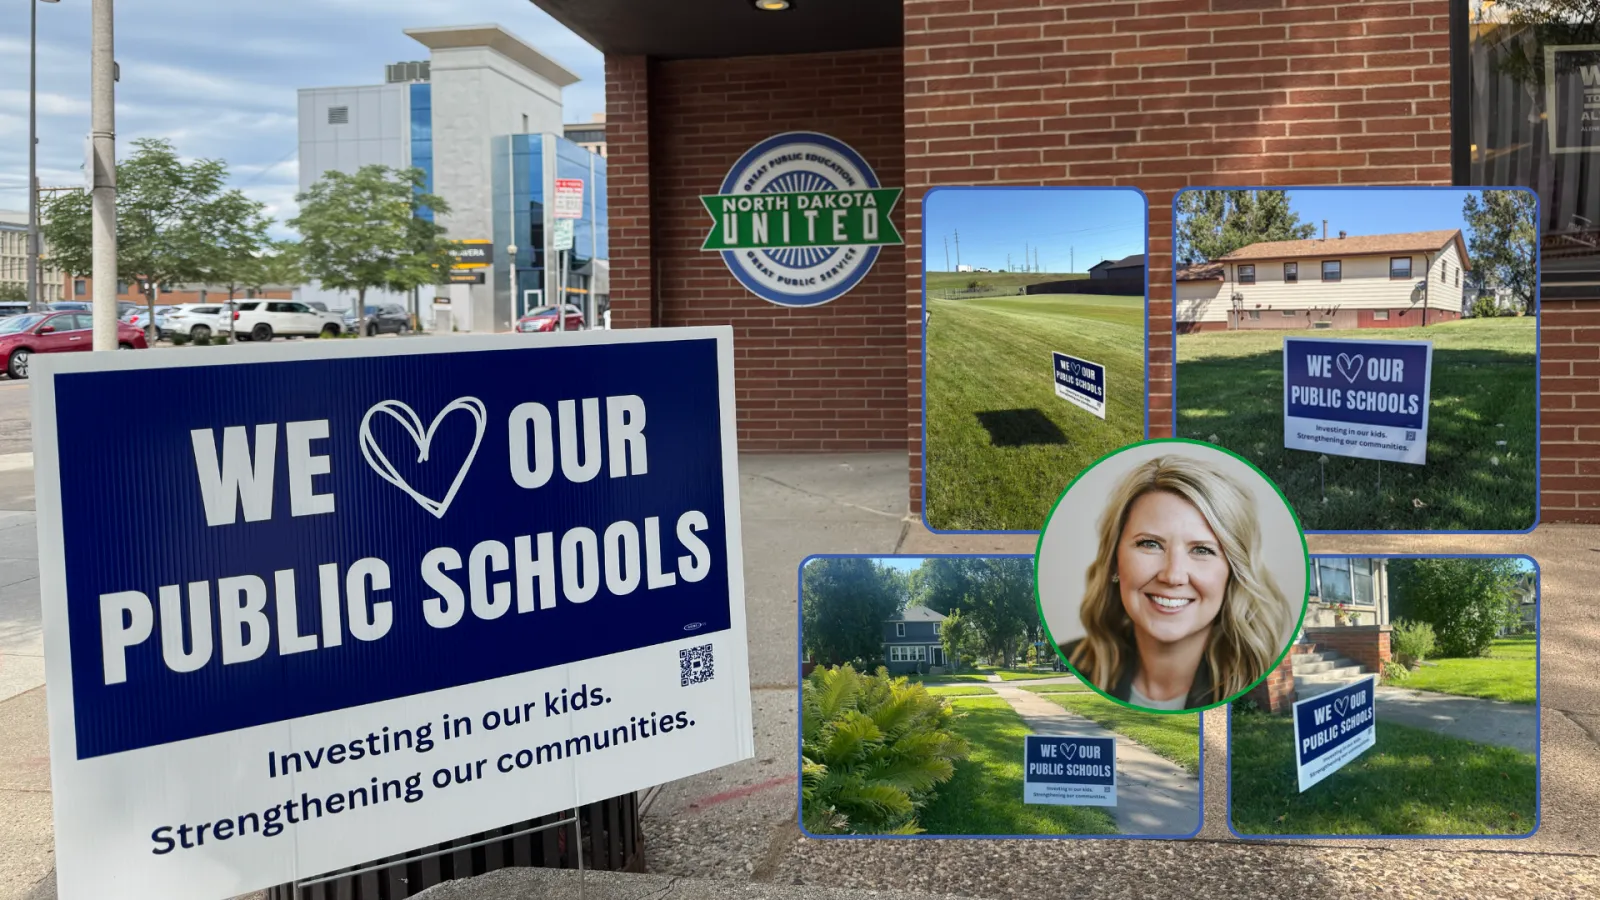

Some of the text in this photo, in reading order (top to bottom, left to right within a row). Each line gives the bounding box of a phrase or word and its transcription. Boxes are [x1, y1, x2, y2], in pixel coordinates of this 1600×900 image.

[1581, 112, 1600, 120] AL
[744, 153, 855, 191] GREAT PUBLIC EDUCATION
[723, 193, 876, 212] NORTH DAKOTA
[723, 208, 878, 244] UNITED
[747, 248, 857, 286] GREAT PUBLIC SERVICE
[1056, 371, 1074, 384] PUBLIC
[1075, 378, 1102, 396] SCHOOLS
[1060, 360, 1095, 380] WE OUR
[1307, 355, 1404, 382] WE OUR
[1291, 385, 1419, 415] PUBLIC SCHOOLS
[1297, 432, 1344, 445] Strengthening
[1359, 441, 1409, 451] communities.
[1316, 425, 1347, 435] Investing
[1370, 430, 1387, 438] kids.
[190, 393, 648, 527] WE OUR
[99, 509, 711, 686] PUBLIC SCHOOLS
[1314, 690, 1366, 725] WE OUR
[267, 683, 613, 778] Investing in our kids.
[1303, 725, 1338, 754] PUBLIC
[1340, 707, 1372, 734] SCHOOLS
[1041, 744, 1100, 759] WE OUR
[150, 708, 696, 855] Strengthening our communities.
[1029, 763, 1111, 777] PUBLIC SCHOOLS
